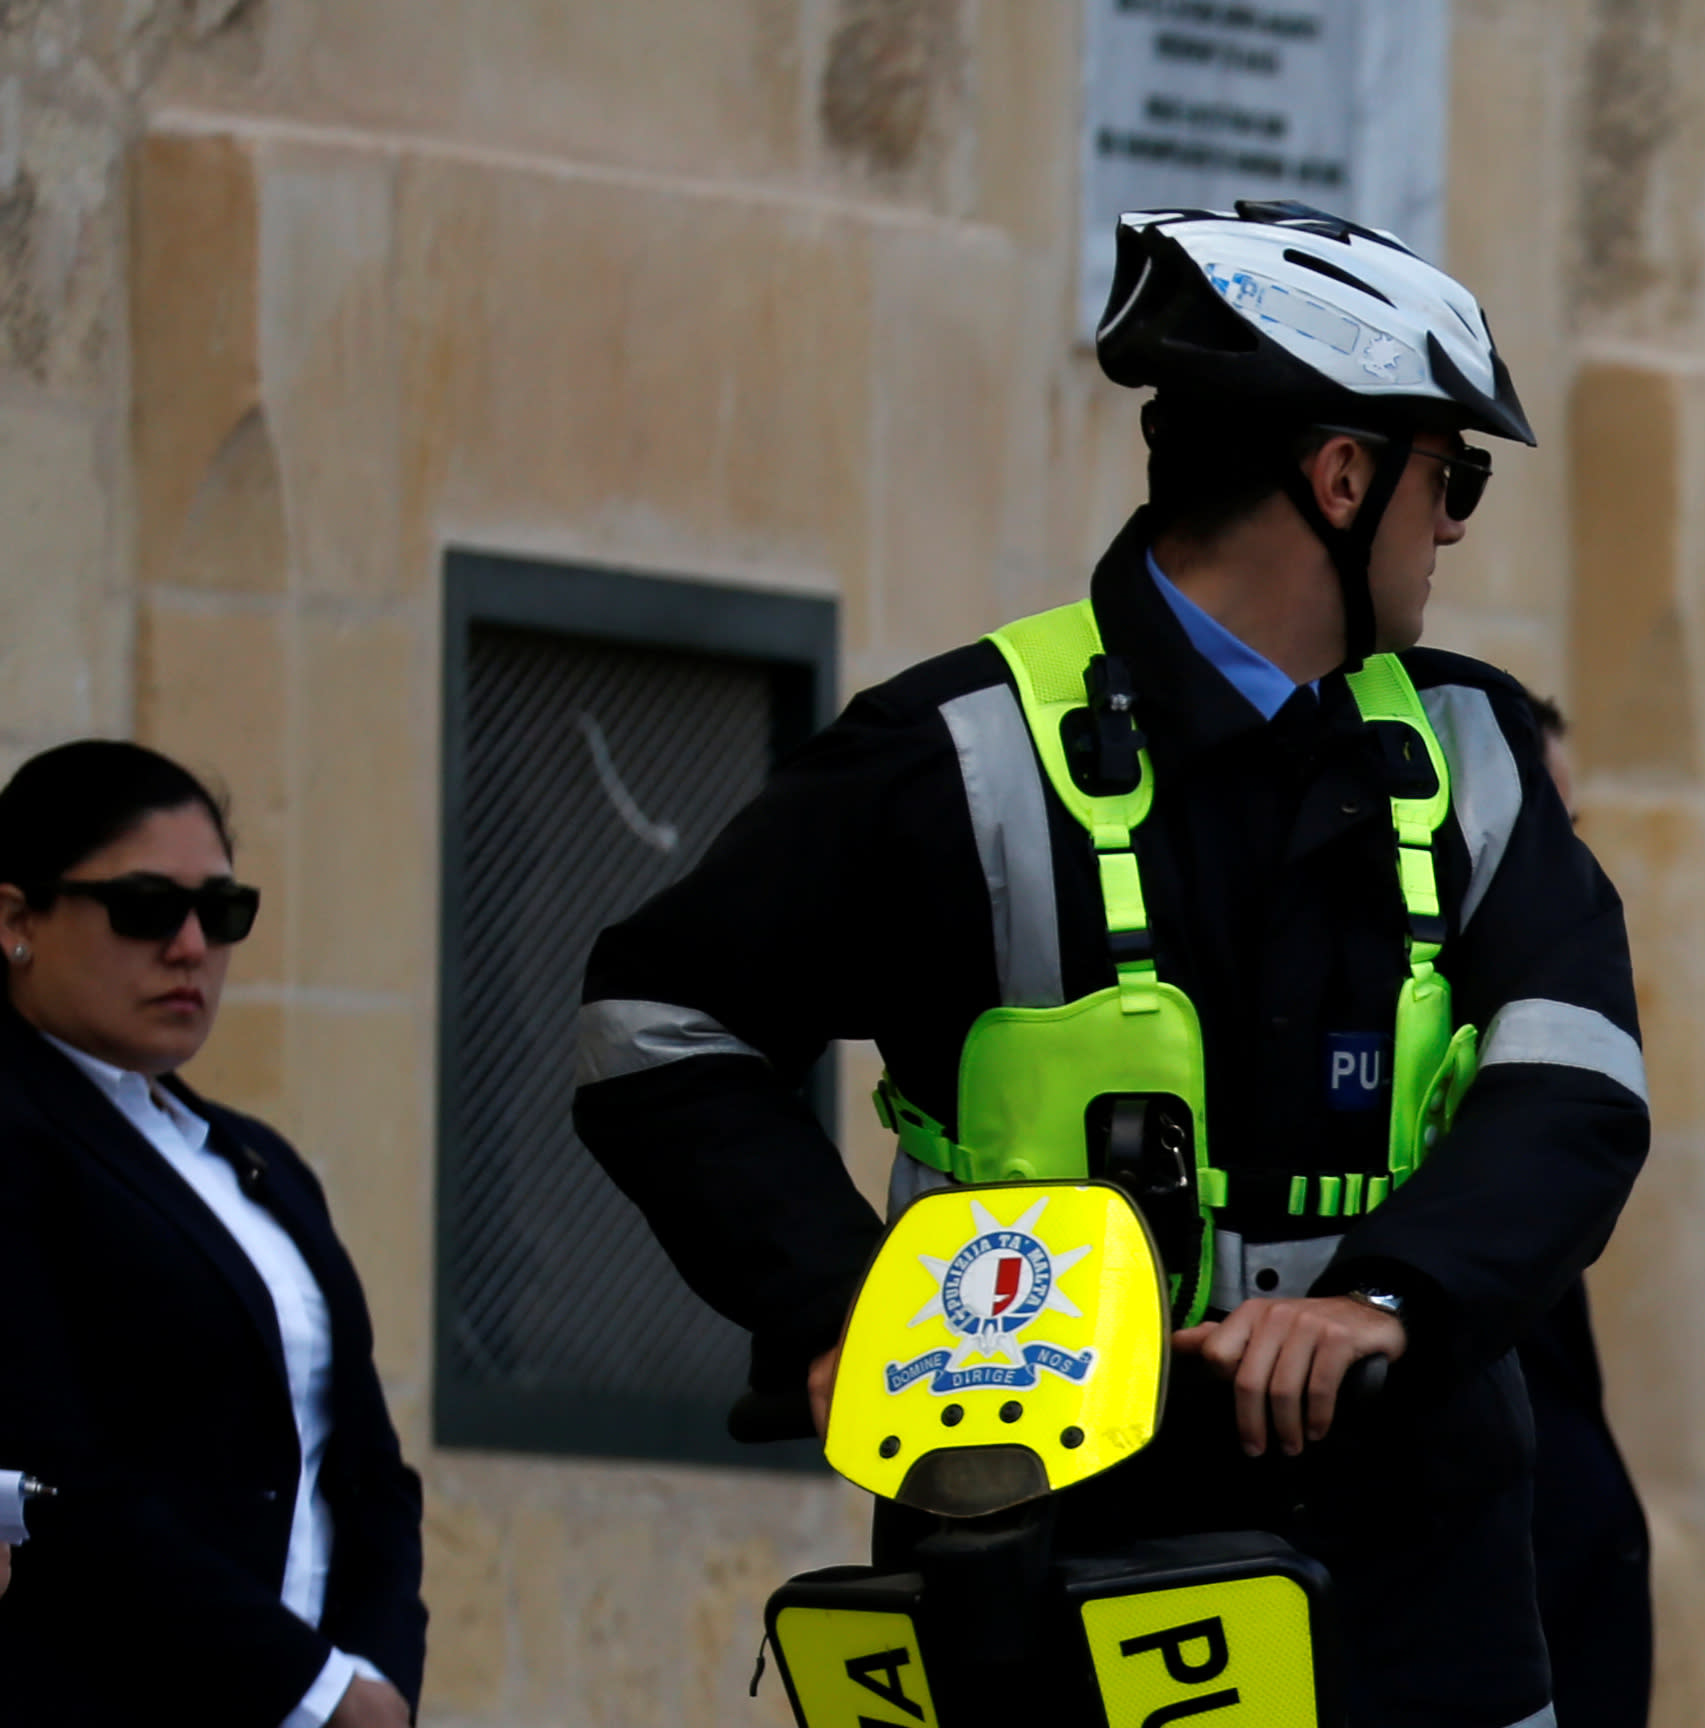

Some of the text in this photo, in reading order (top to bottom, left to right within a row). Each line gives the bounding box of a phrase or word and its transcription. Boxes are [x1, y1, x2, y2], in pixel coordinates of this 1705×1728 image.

[944, 1238, 992, 1311] PULIZIJA
[1025, 1247, 1049, 1306] MALTA
[892, 1348, 1073, 1388] DOMINE DIRIGE NOS
